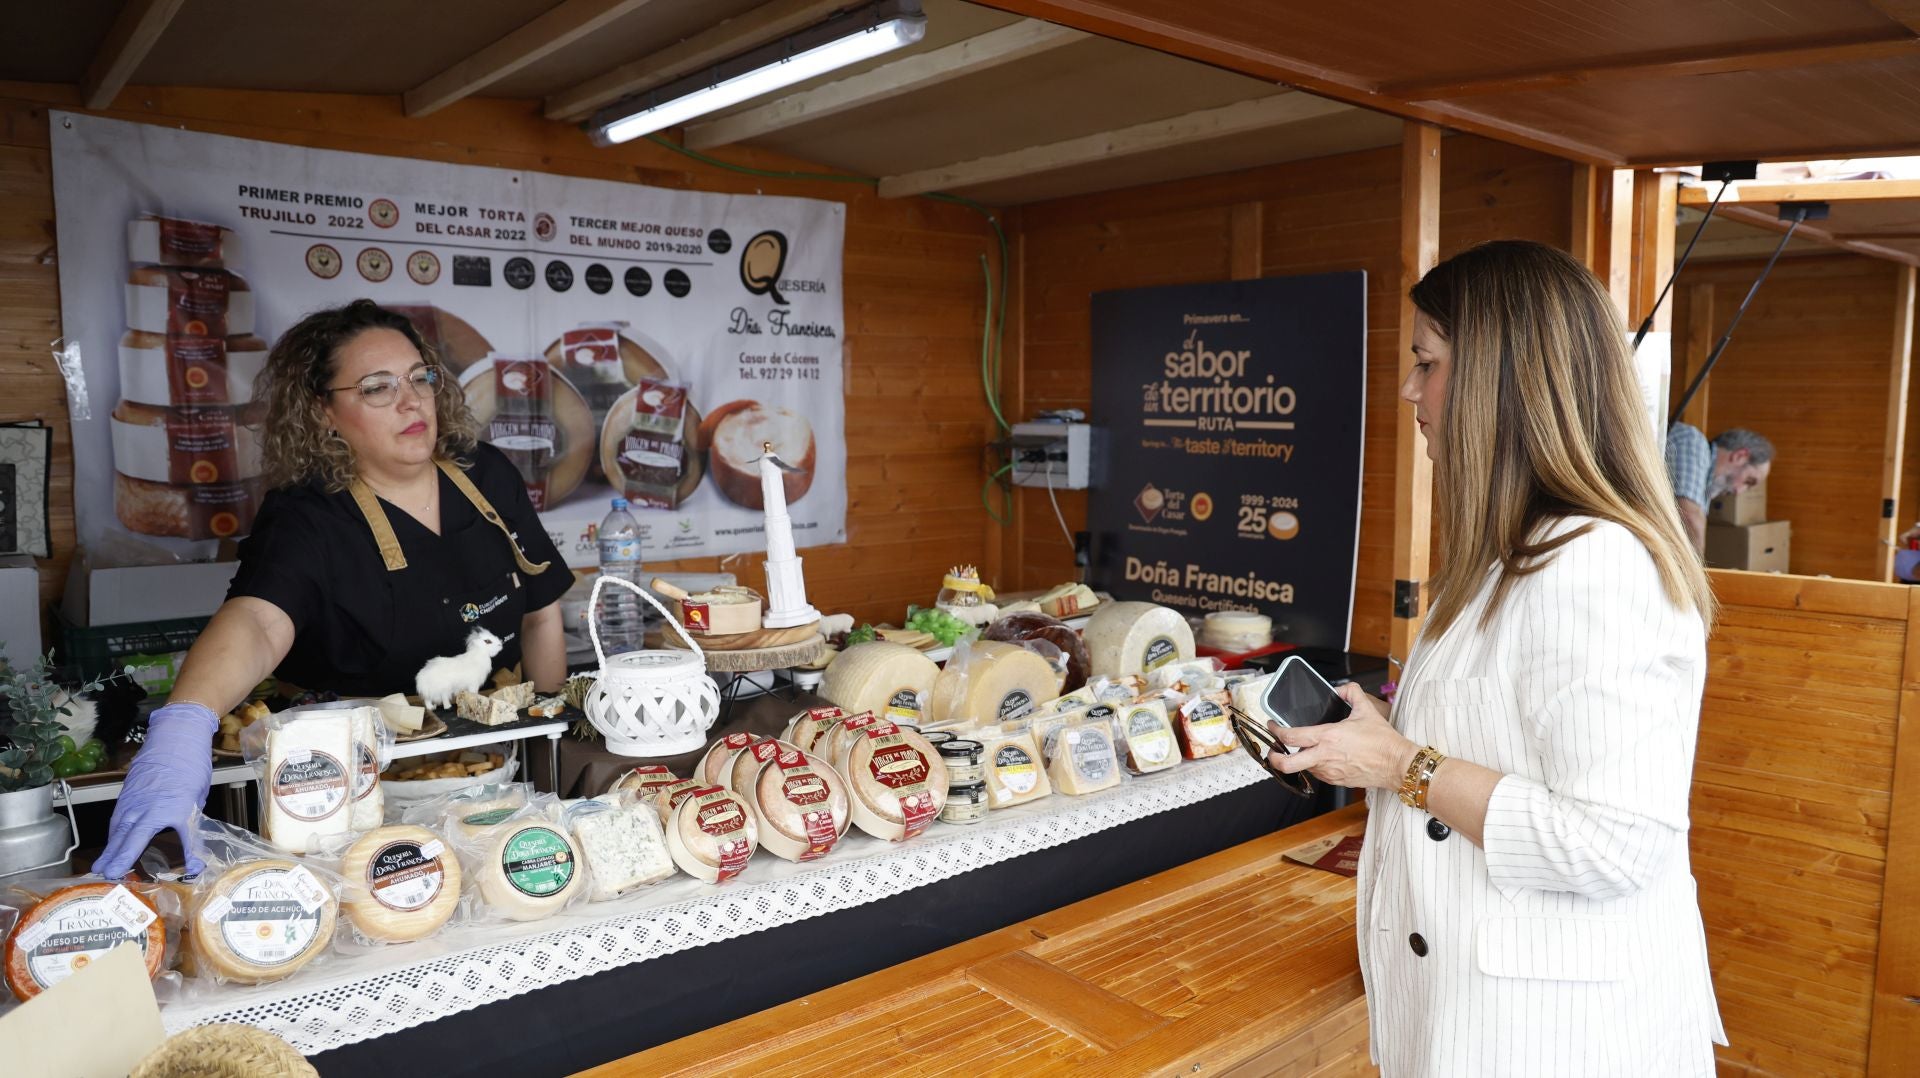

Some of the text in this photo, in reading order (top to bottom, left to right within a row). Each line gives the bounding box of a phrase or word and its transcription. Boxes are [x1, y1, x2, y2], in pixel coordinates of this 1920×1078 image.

[238, 185, 363, 209] PRIMER PREMIO
[239, 205, 364, 229] TRUJILLO 2022
[415, 202, 526, 222] MEJOR TORTA
[415, 222, 526, 241] DEL CASAR 2022
[569, 216, 704, 238] TERCER MEJOR QUESO
[569, 234, 703, 254] DEL MUNDO 2019-2020
[1183, 314, 1228, 325] Primavera
[739, 352, 819, 365] Casar de Cáceres
[1165, 340, 1251, 378] sabor
[760, 368, 777, 379] 927
[780, 368, 793, 379] 29
[1160, 376, 1297, 415] territorio
[1198, 417, 1235, 431] RUTA
[1185, 437, 1220, 454] taste
[1232, 438, 1294, 463] territory
[1164, 488, 1185, 500] Torta
[1240, 494, 1265, 506] 1999
[1271, 497, 1299, 509] 2024
[1167, 500, 1181, 509] del
[1161, 509, 1186, 521] Casar
[1237, 506, 1267, 534] 25
[1125, 556, 1295, 604] Doña Francisca
[391, 870, 424, 884] AHUMADO
[231, 906, 256, 914] QUESO
[58, 917, 115, 931] FRANCISC
[41, 937, 71, 948] QUESO
[73, 936, 85, 945] DE
